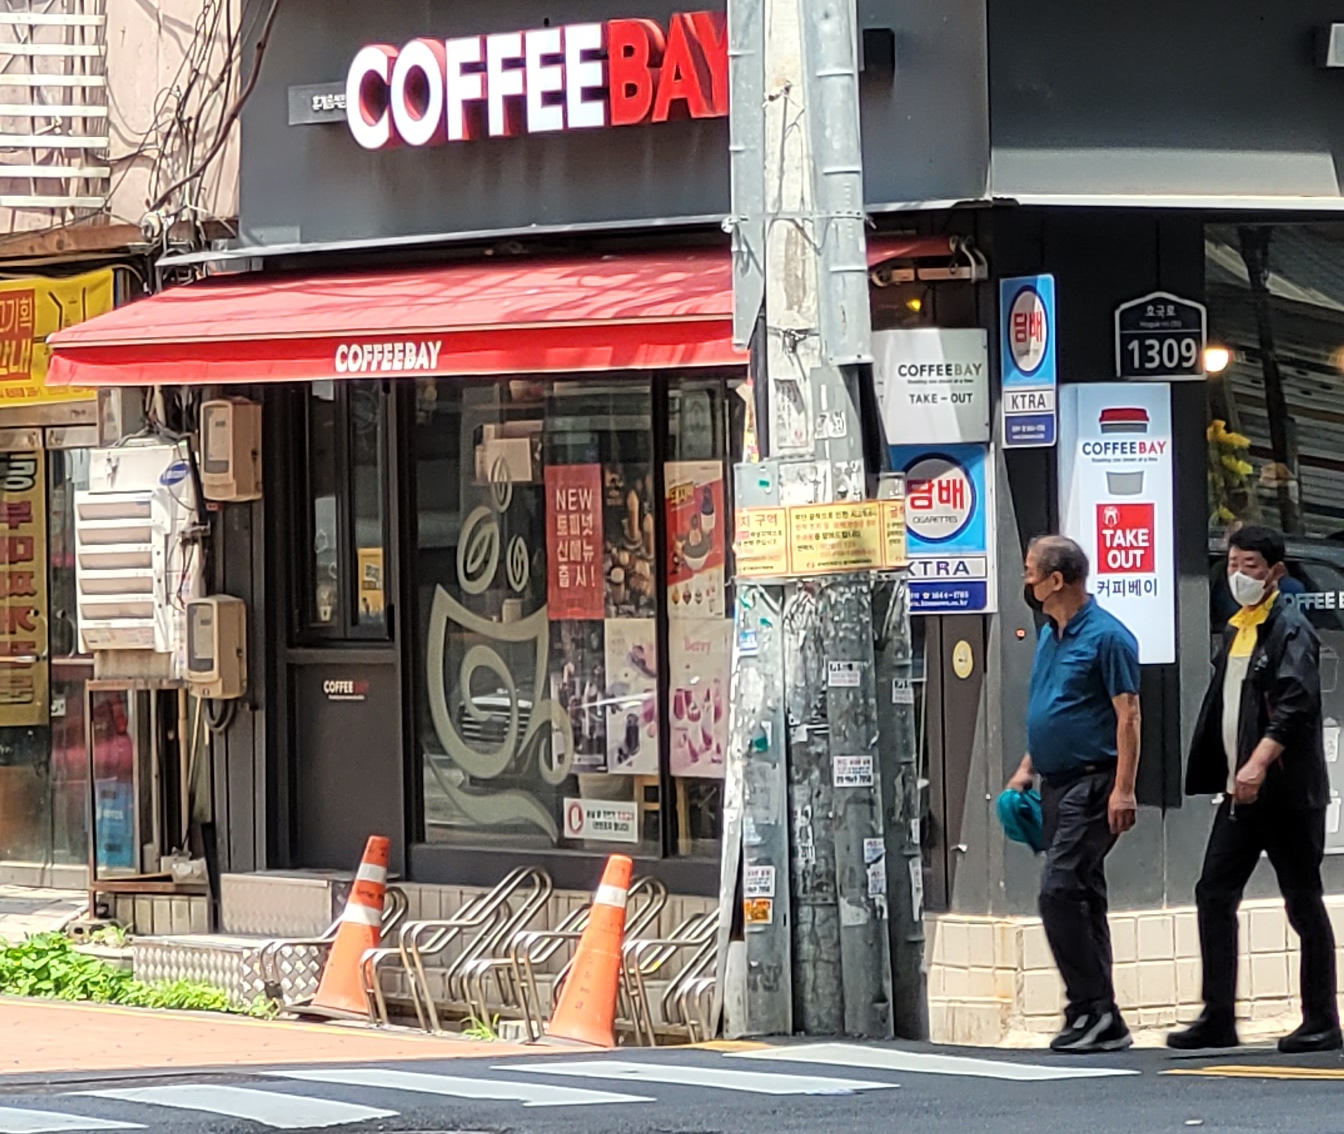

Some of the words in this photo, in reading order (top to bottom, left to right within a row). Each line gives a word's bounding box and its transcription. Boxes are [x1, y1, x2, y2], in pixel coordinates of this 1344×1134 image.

[346, 10, 729, 150] COFFEEBAY
[1014, 312, 1043, 343] 담배
[335, 341, 441, 373] COFFEEBAY
[1127, 338, 1197, 369] 1309
[898, 363, 982, 377] COFFEEBAY
[909, 393, 938, 404] TAKE
[951, 392, 973, 403] OUT
[1011, 394, 1046, 410] KTRA
[1082, 442, 1166, 456] COFFEEBAY
[556, 488, 593, 511] NEW
[908, 478, 965, 510] 담배
[1102, 529, 1150, 547] TAKE
[1107, 550, 1145, 569] OUT
[1096, 578, 1158, 598] 커피베이
[1283, 592, 1336, 610] OFFEE
